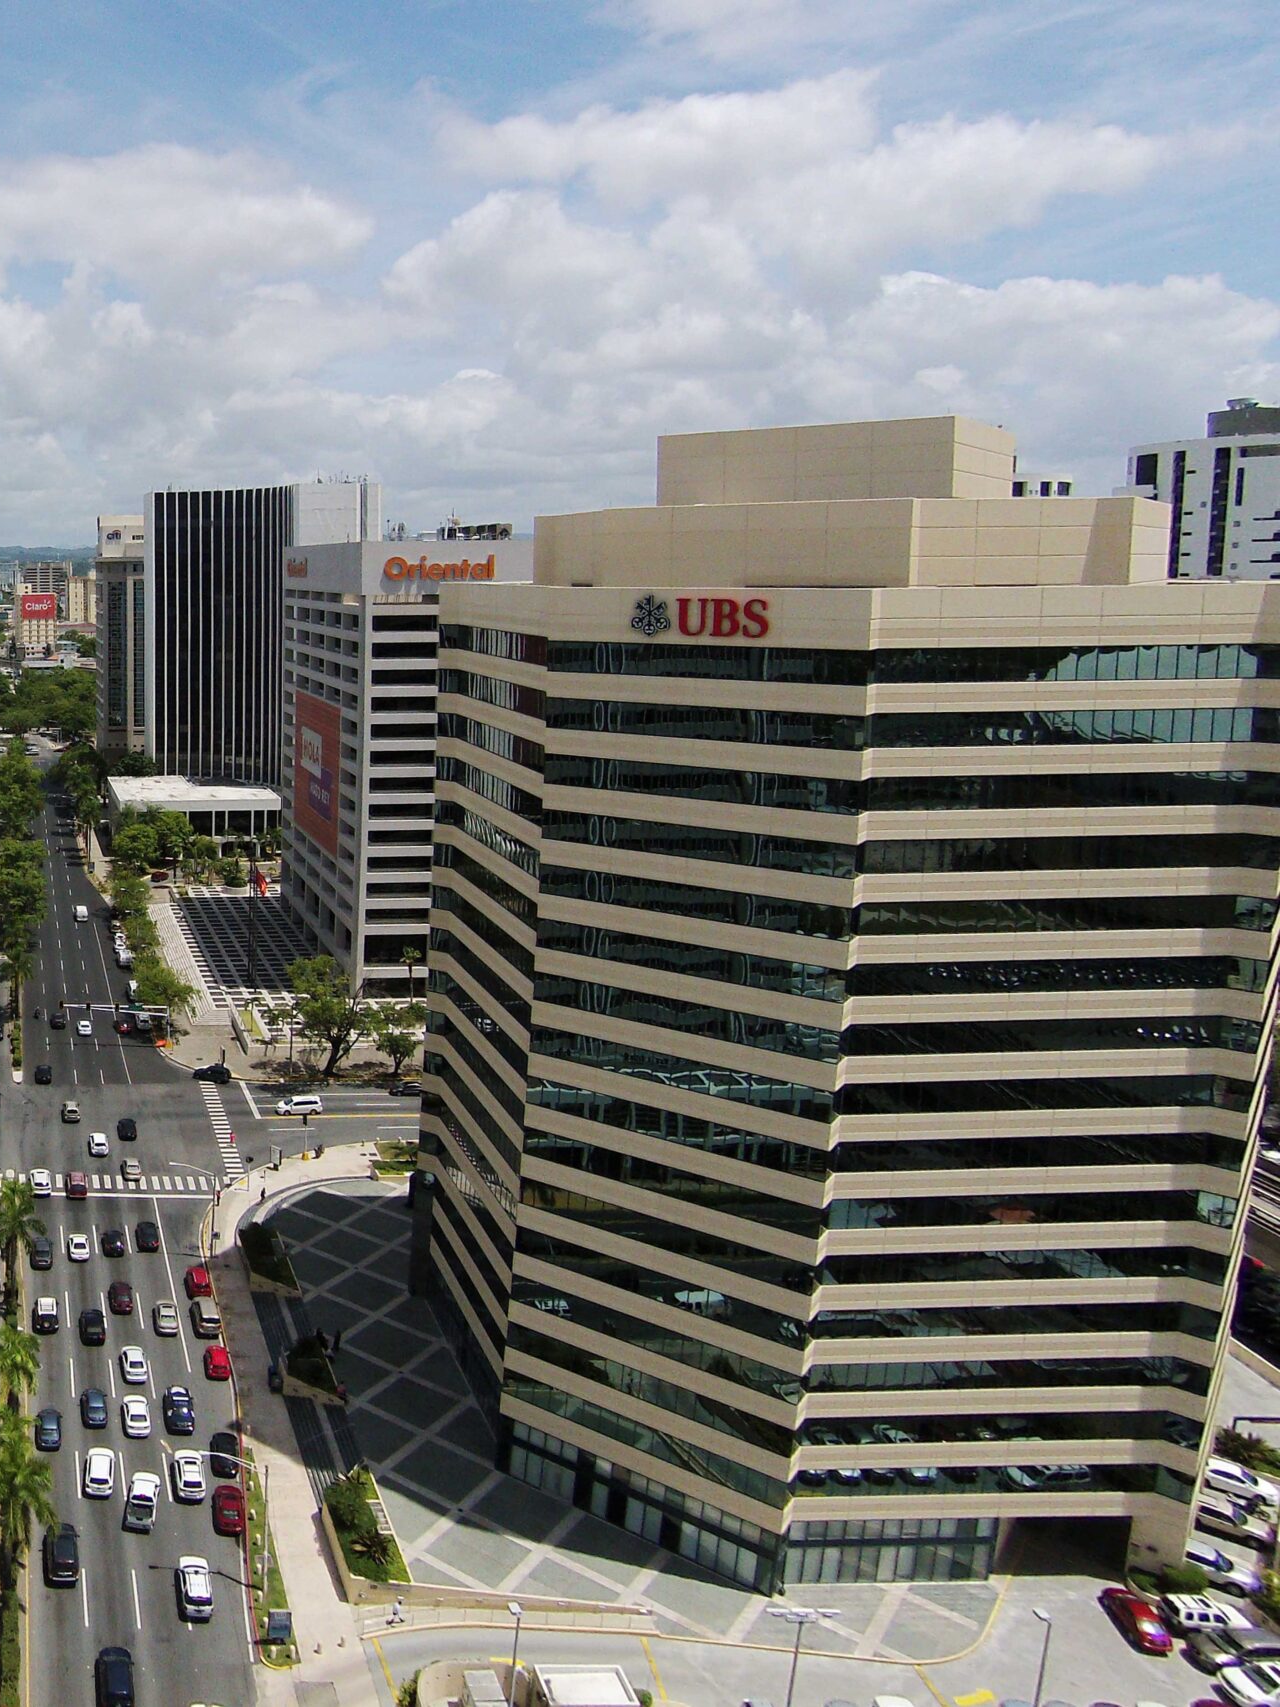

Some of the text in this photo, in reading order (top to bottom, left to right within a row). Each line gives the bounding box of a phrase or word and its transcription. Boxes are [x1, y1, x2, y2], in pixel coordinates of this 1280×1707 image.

[383, 553, 496, 581] Oriental
[25, 601, 49, 611] Claro
[676, 598, 769, 638] UBS
